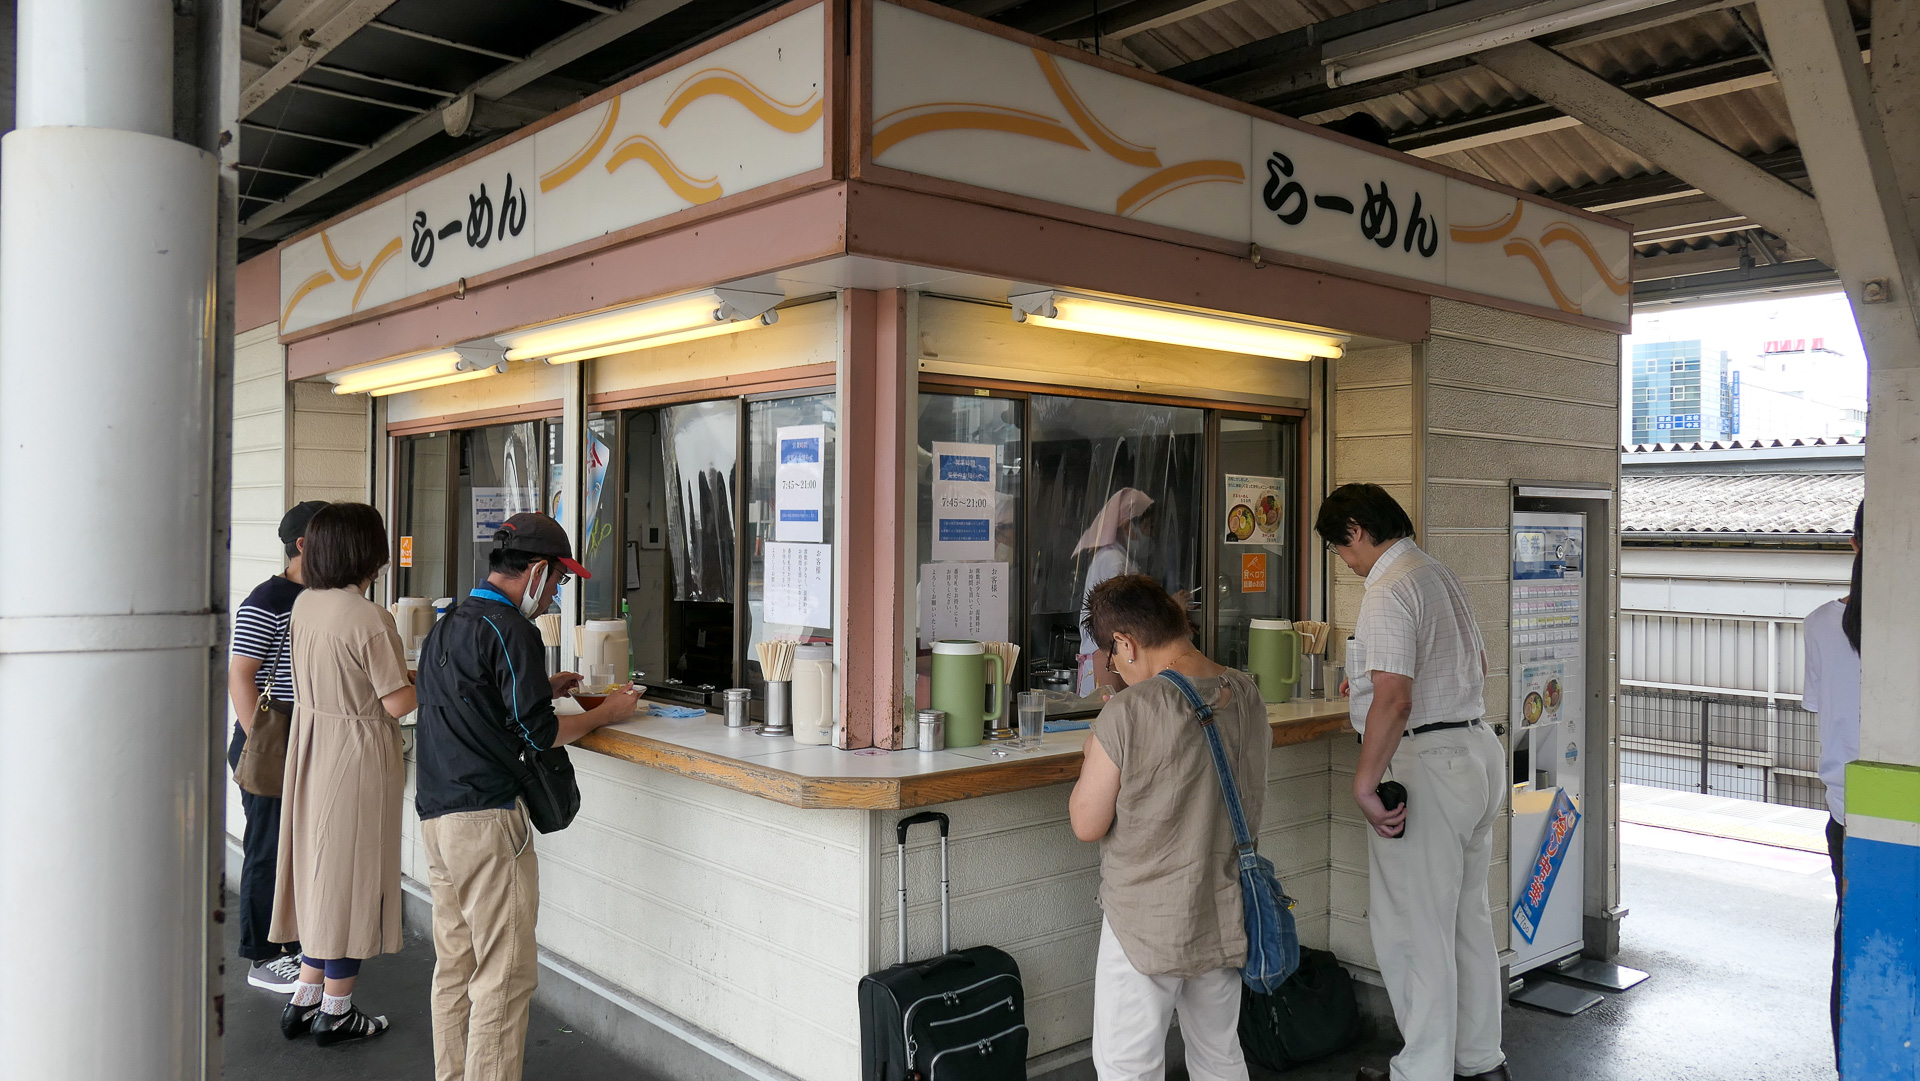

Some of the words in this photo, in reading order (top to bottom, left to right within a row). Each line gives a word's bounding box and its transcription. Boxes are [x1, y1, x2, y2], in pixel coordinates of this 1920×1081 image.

[411, 172, 527, 268] らーめん
[1263, 151, 1438, 258] らーめん
[1520, 535, 1541, 555] 食券
[1244, 570, 1265, 579] 食べログ
